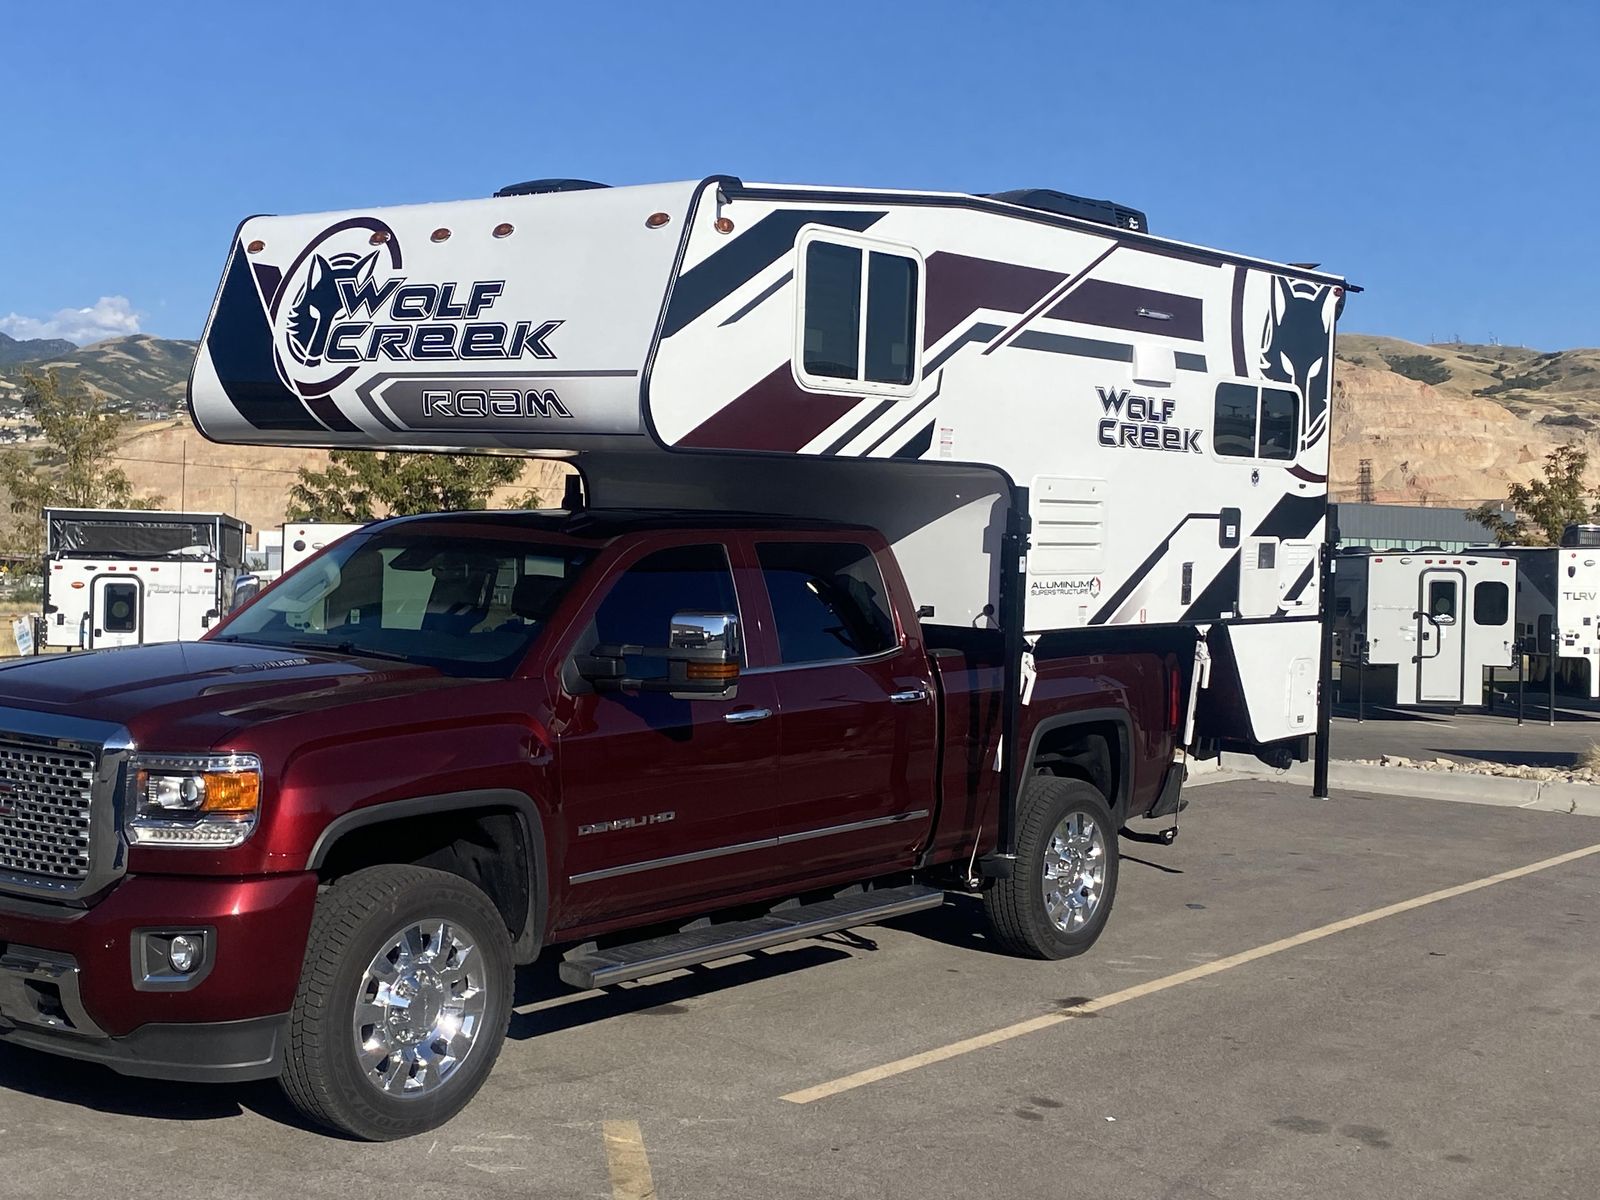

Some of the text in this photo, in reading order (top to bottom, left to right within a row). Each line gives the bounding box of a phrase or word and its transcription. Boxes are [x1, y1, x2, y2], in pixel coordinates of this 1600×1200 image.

[335, 276, 505, 321] WOLF
[325, 319, 566, 362] CREEK
[422, 389, 573, 418] ROAM
[1094, 385, 1176, 424] WOLF
[1097, 417, 1204, 454] CREEK
[1030, 588, 1089, 596] SUPERSTRUCTURE
[1031, 580, 1090, 589] ALUMINUM
[1563, 592, 1597, 601] TLRV
[577, 811, 676, 836] DENALI HD
